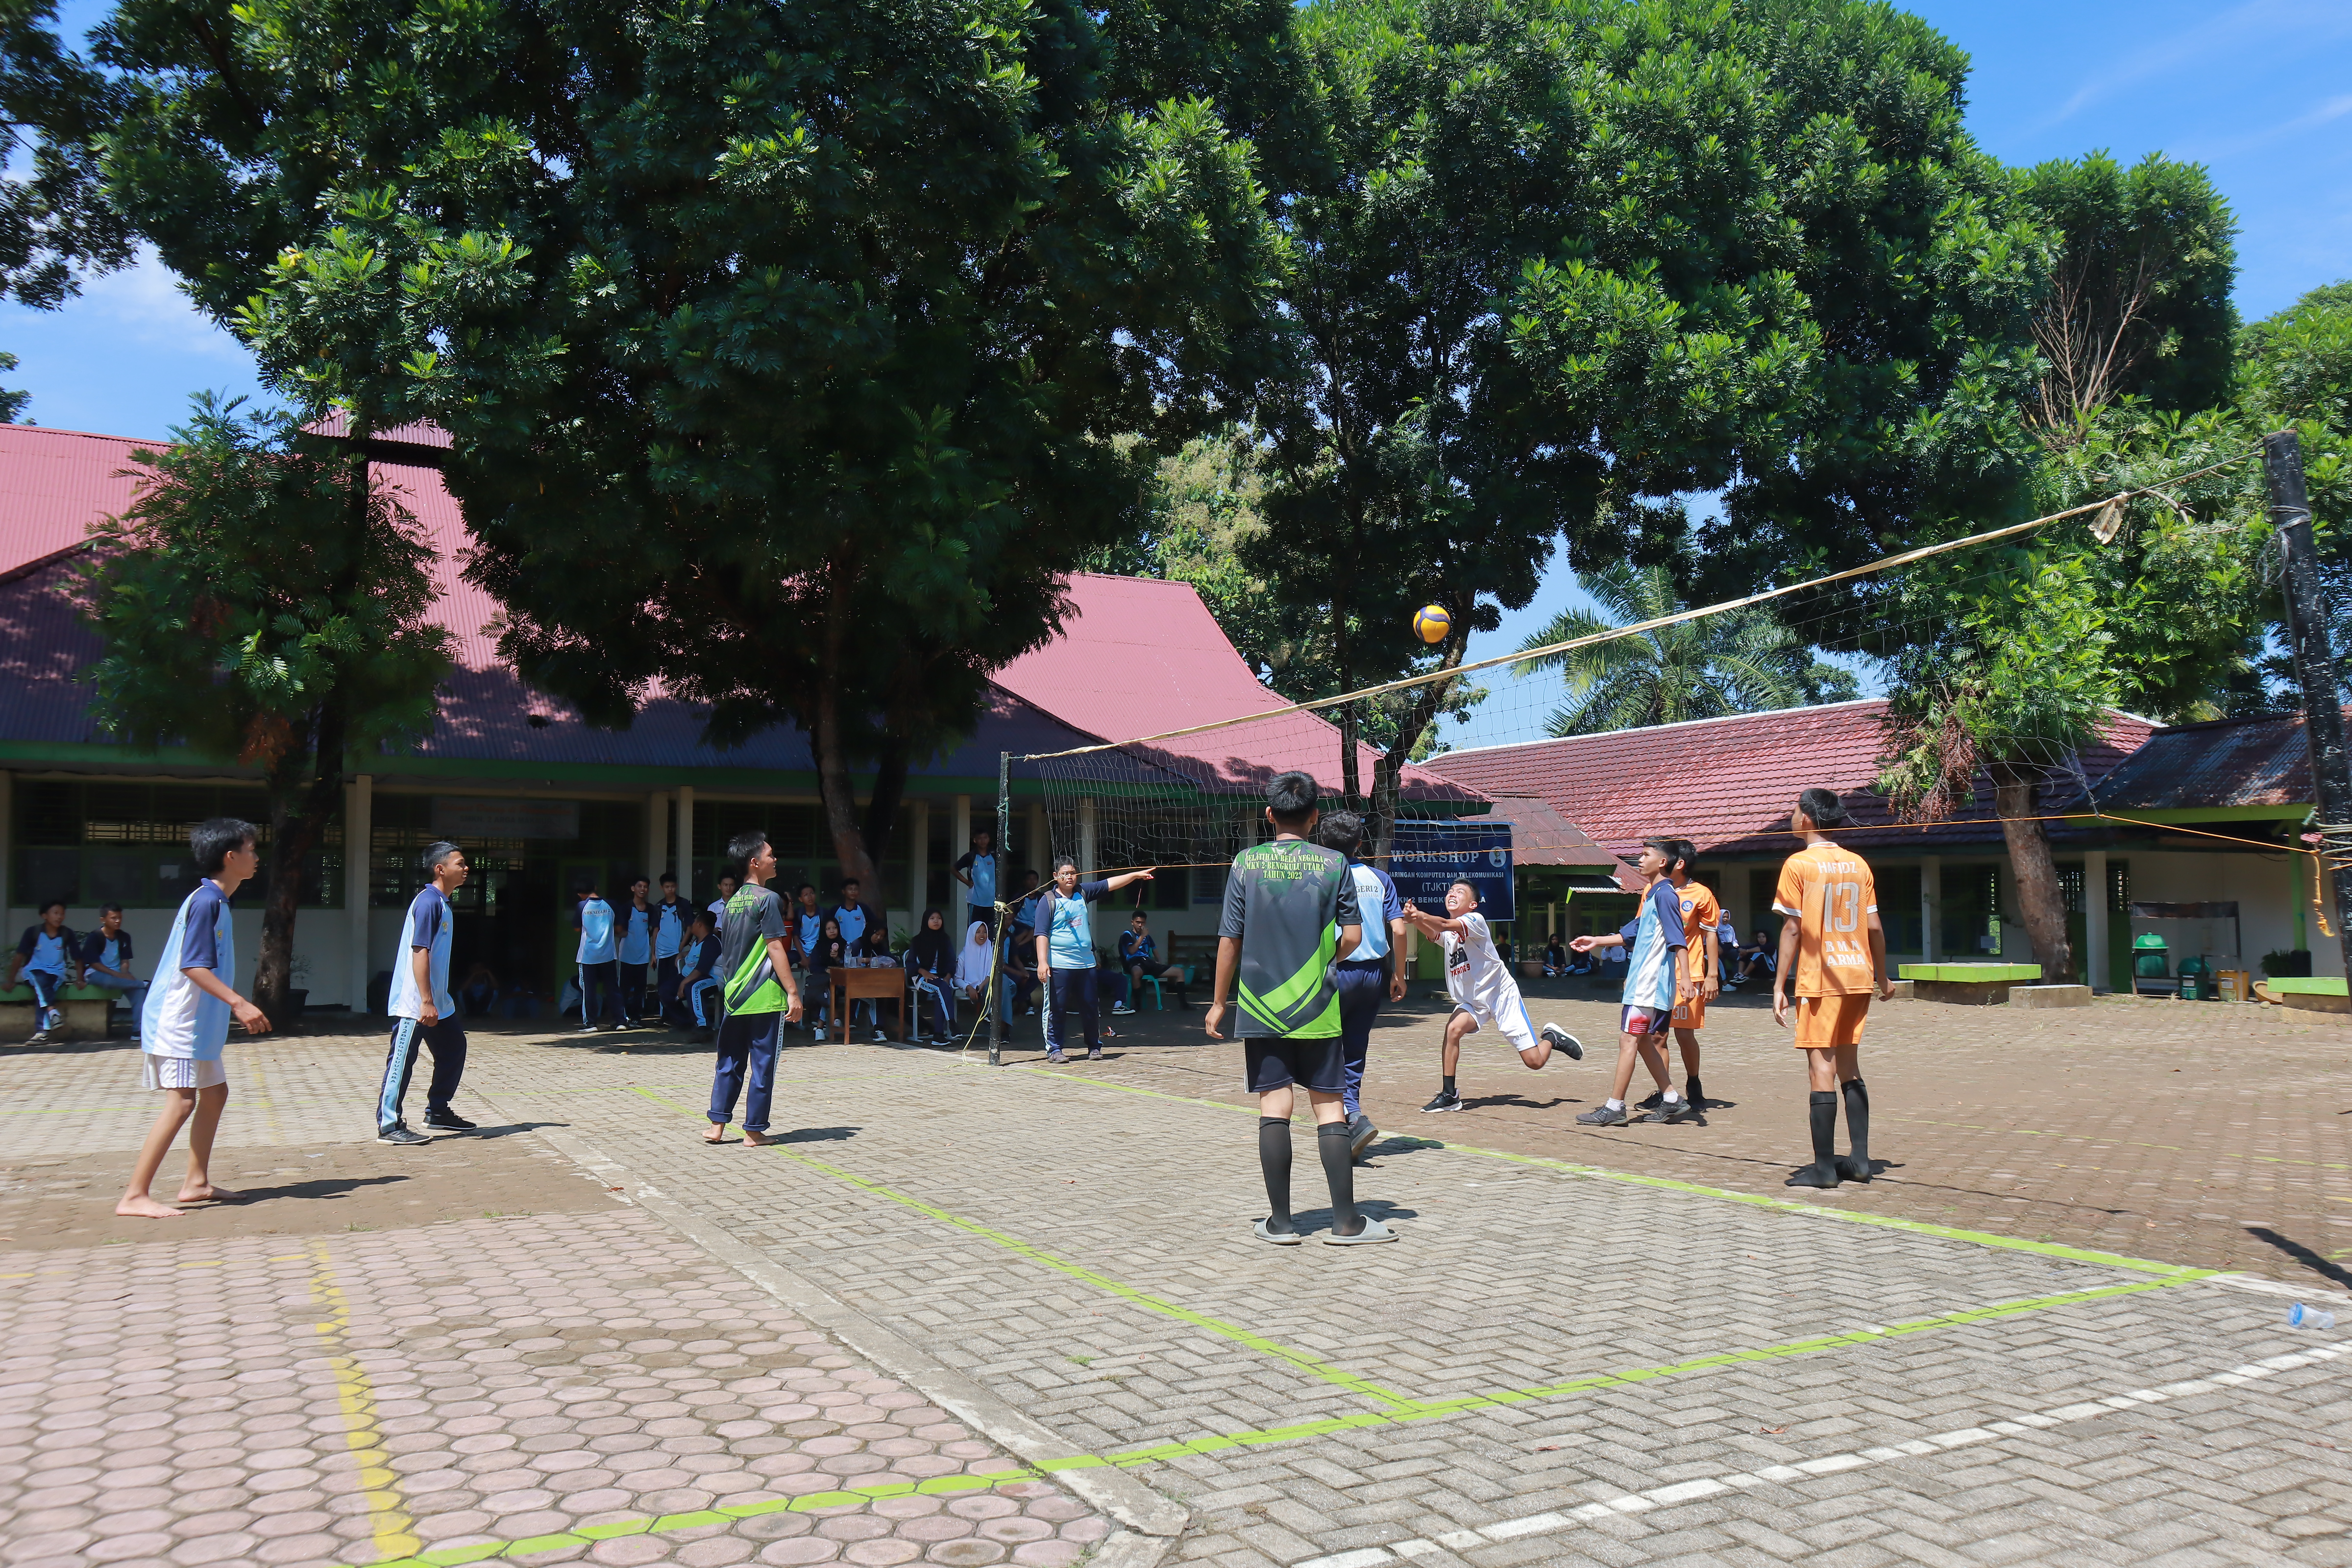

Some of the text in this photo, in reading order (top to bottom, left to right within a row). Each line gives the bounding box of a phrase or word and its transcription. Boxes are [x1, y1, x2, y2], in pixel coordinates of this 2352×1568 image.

[1280, 854, 1296, 862] BELA
[1298, 854, 1323, 862] NEGARA
[1390, 850, 1479, 863] WORKSHOP
[1267, 861, 1301, 870] BENGKULU
[1303, 862, 1325, 871] UTARA
[1817, 861, 1858, 874] HAFIDZ
[1263, 870, 1302, 880] TAHUN 2023
[1822, 882, 1859, 932] 13
[1826, 953, 1866, 967] ARMA
[1673, 1005, 1688, 1020] 30
